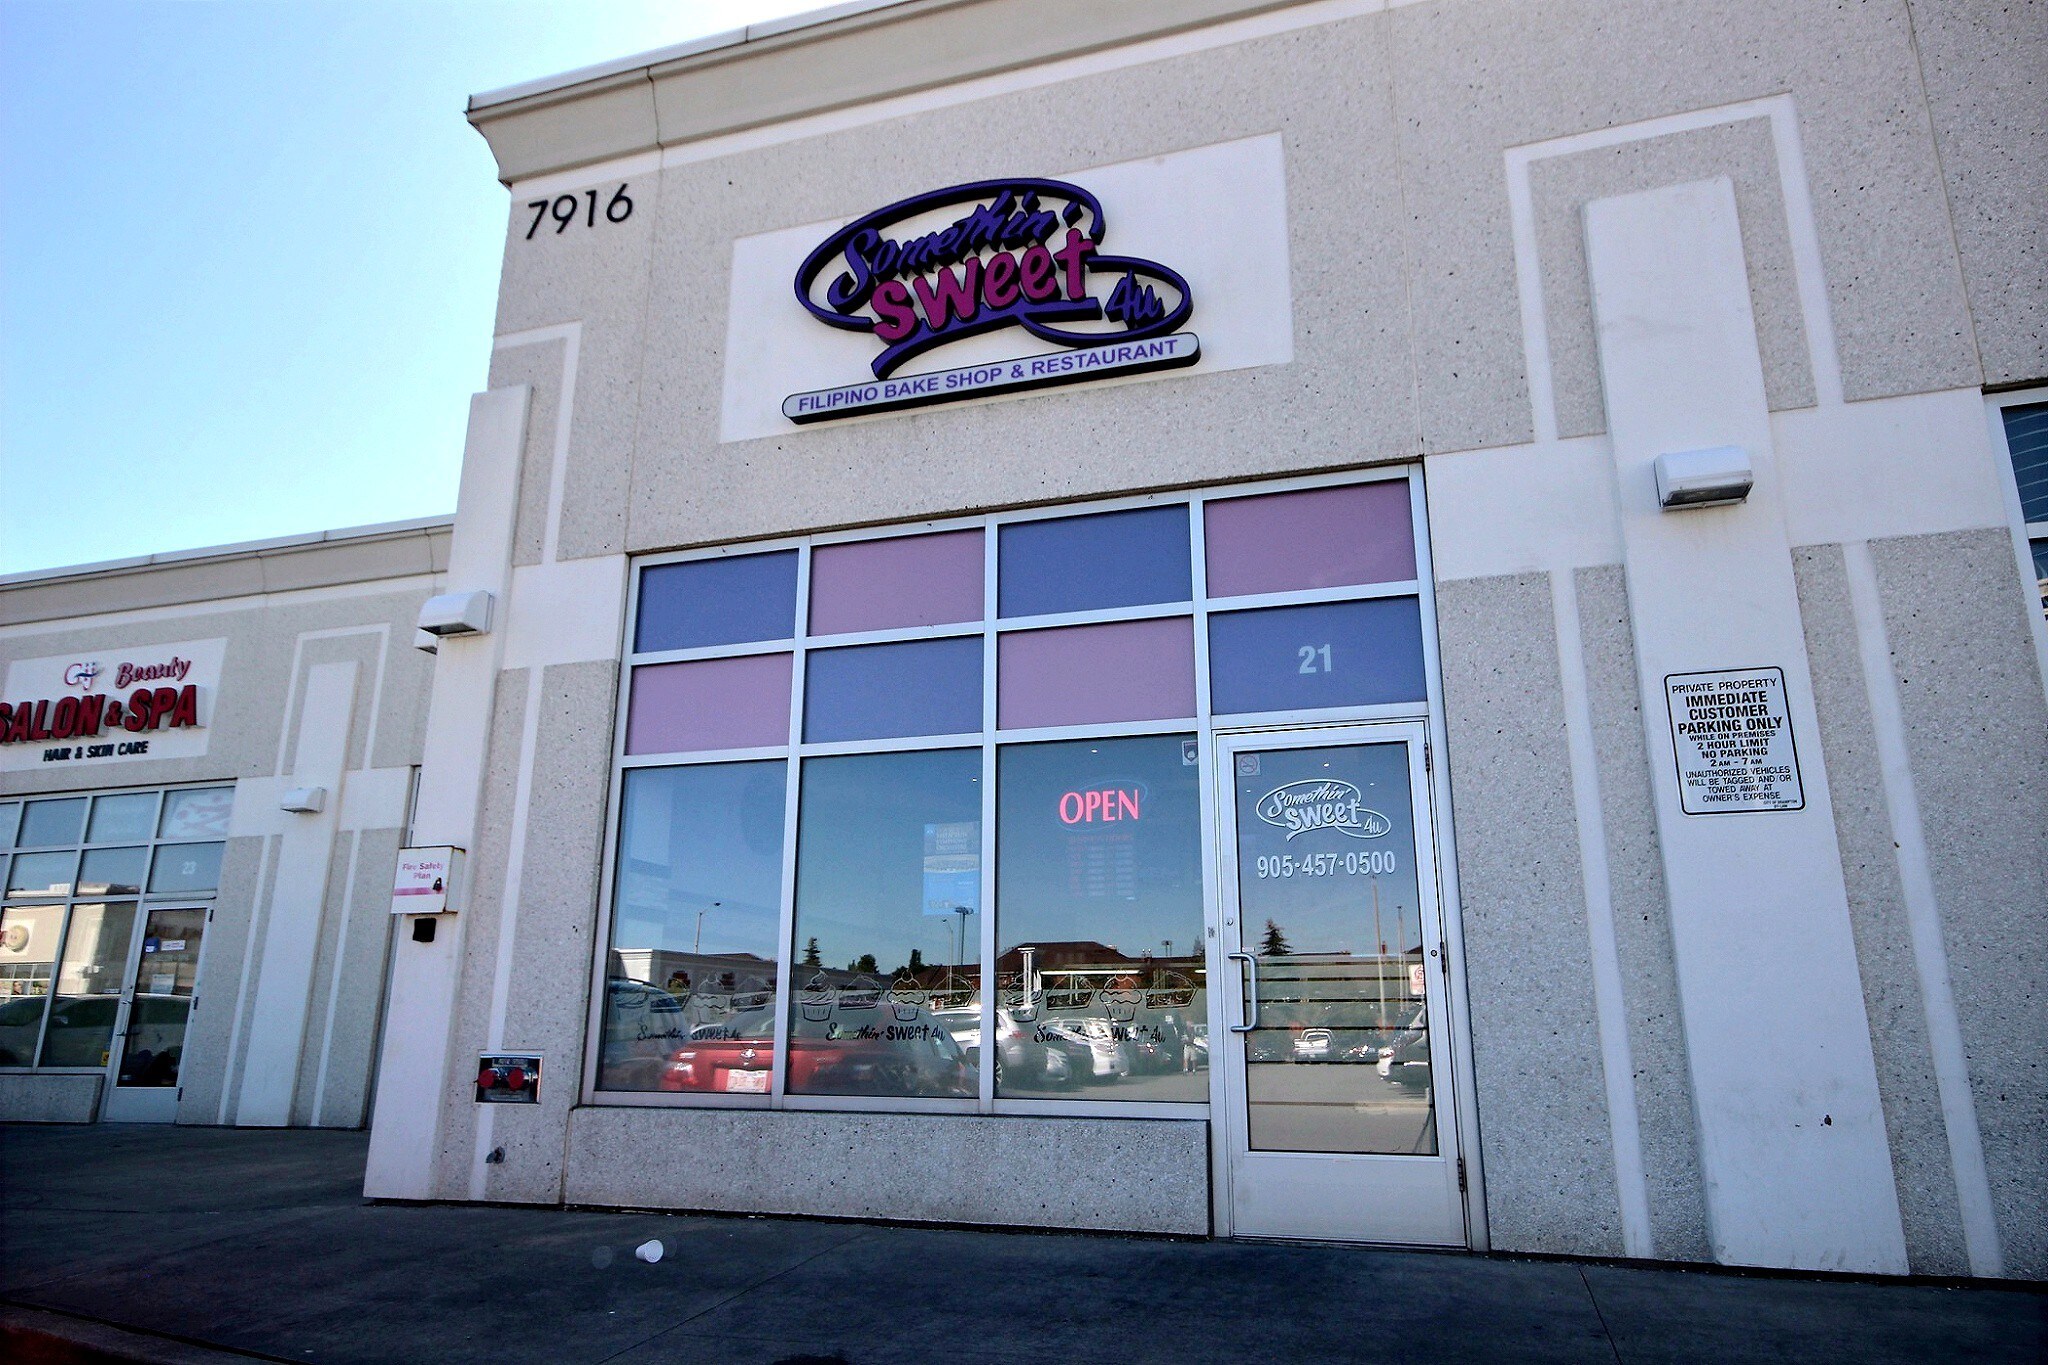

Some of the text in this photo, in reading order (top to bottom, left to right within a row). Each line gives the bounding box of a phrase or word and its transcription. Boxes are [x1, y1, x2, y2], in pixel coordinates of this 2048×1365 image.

[526, 183, 633, 240] 7916
[798, 339, 1178, 412] FILIPINO BAKE SHOP & RESTAURANT
[1298, 644, 1332, 674] 21
[114, 657, 191, 689] Beauty
[1672, 678, 1777, 694] PRIVATE PROPERTY
[1686, 691, 1768, 708] IMMEDIATE
[0, 685, 197, 744] SALON & SPA
[1689, 704, 1769, 721] CUSTOMER
[1678, 716, 1783, 735] PARKING ONLY
[1689, 730, 1776, 742] WHILE ON PREMISES
[43, 741, 149, 761] HAIR & SKIN CARE
[1697, 738, 1770, 750] 2 HOUR LIMIT
[1702, 747, 1768, 759] NO PARKING
[1710, 759, 1717, 767] 2
[1686, 765, 1791, 779] UNAUTHORIZED VEHICLES
[1687, 779, 1706, 787] WILL
[1709, 778, 1719, 786] BE
[1723, 776, 1755, 785] TAGGED
[1708, 785, 1737, 794] TOWED
[1740, 784, 1760, 792] AWAY
[1702, 791, 1781, 803] OWNER'S EXPENSE
[1059, 789, 1140, 824] OPEN
[182, 860, 197, 875] 23
[420, 861, 443, 871] Safety
[413, 872, 431, 880] Plan
